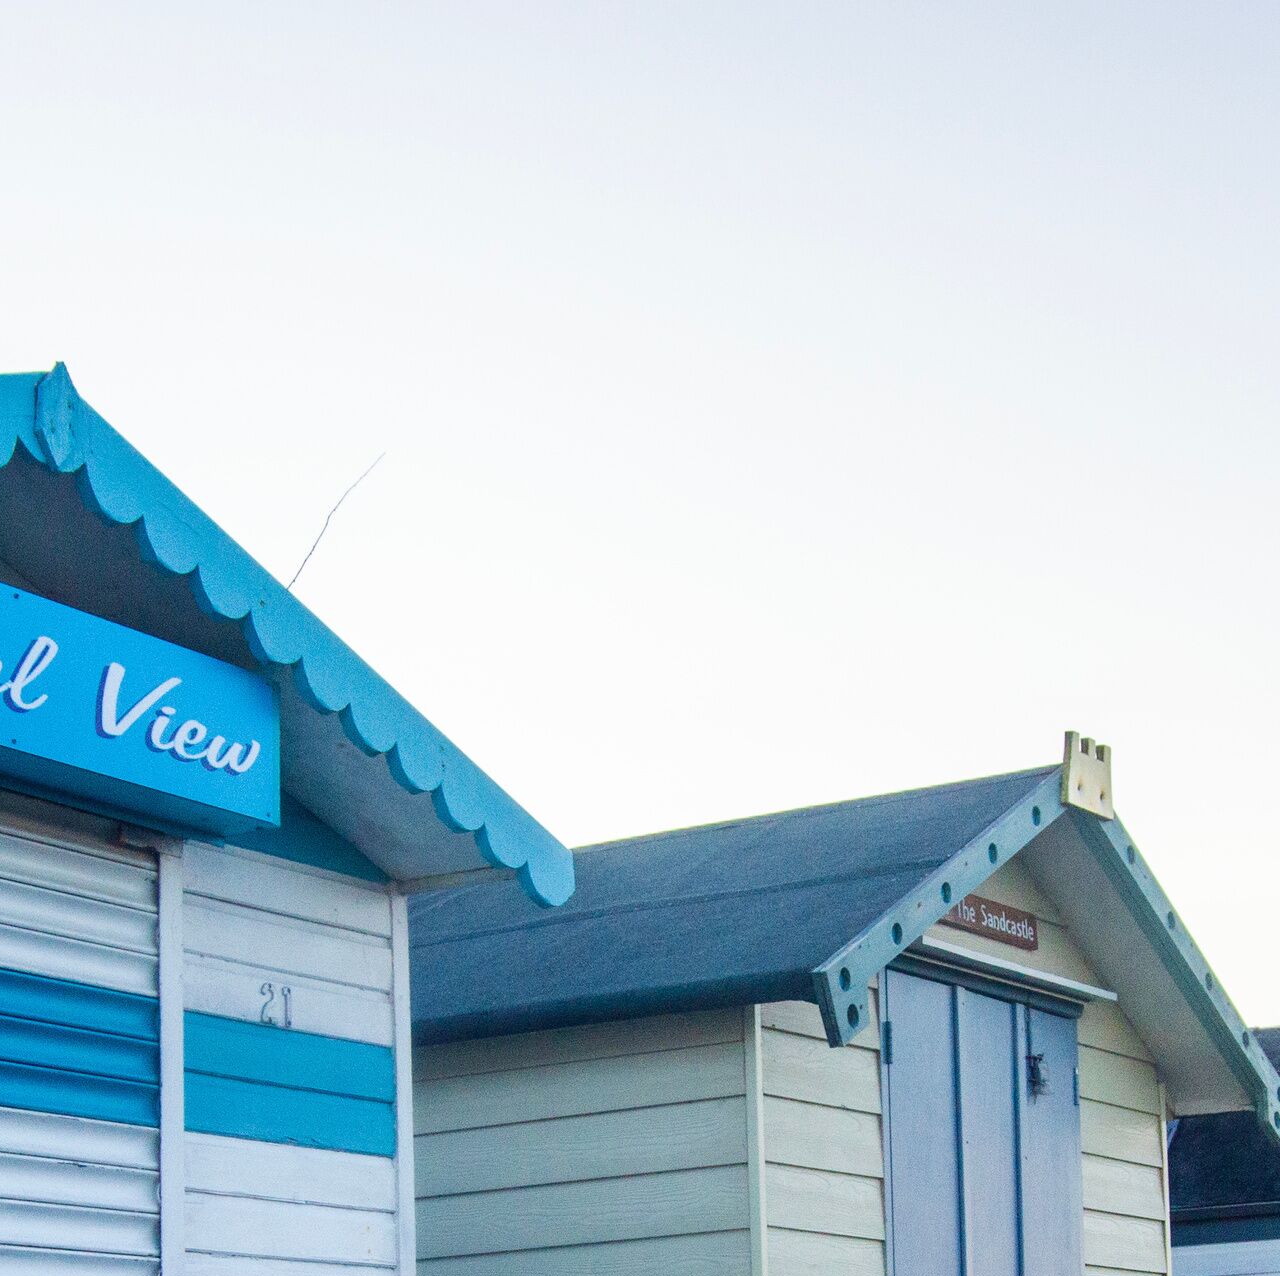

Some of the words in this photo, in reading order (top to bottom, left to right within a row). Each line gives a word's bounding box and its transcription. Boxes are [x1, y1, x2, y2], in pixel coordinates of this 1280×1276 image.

[97, 662, 260, 774] View
[980, 904, 1034, 941] Sandcastle
[260, 982, 292, 1028] 21
